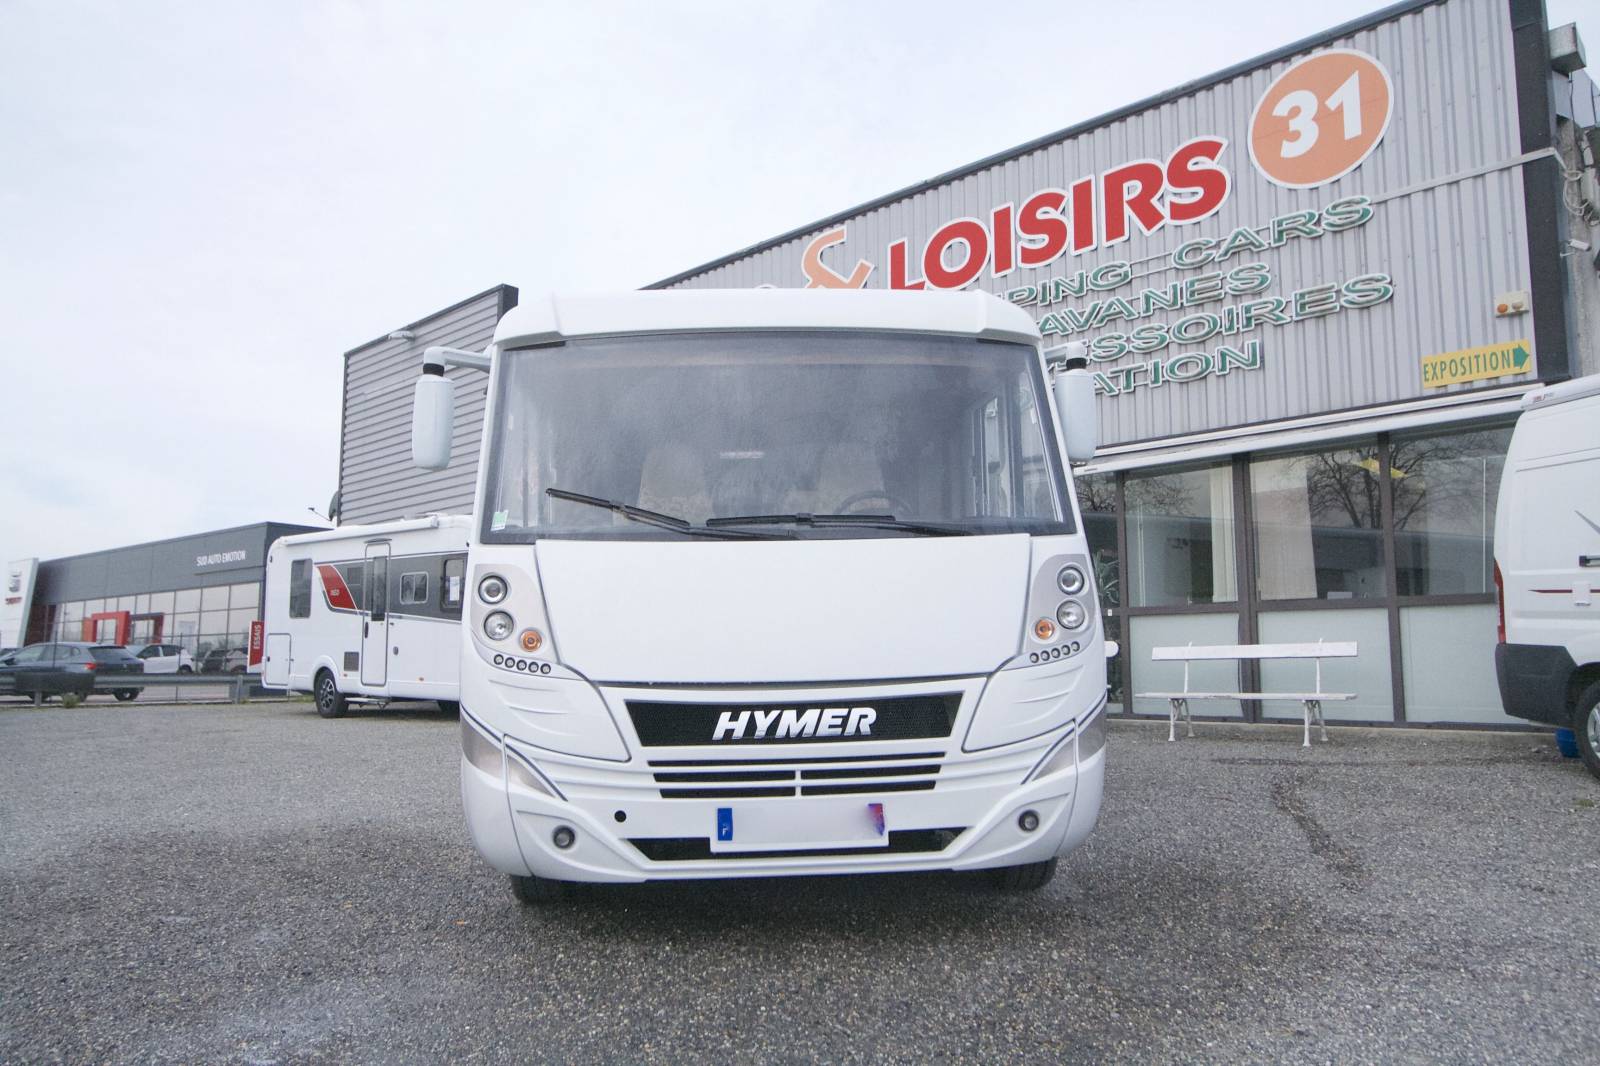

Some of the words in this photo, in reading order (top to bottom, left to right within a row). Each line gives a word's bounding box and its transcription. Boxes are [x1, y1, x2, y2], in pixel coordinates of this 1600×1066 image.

[1271, 69, 1363, 159] 31
[889, 136, 1231, 289] LOISIRS
[1003, 261, 1132, 306] PING
[1172, 196, 1374, 269] CARS
[1039, 262, 1272, 336] AVANES
[1094, 340, 1260, 396] ATION
[1423, 349, 1511, 382] EXPOSITION
[712, 707, 877, 740] HYMER
